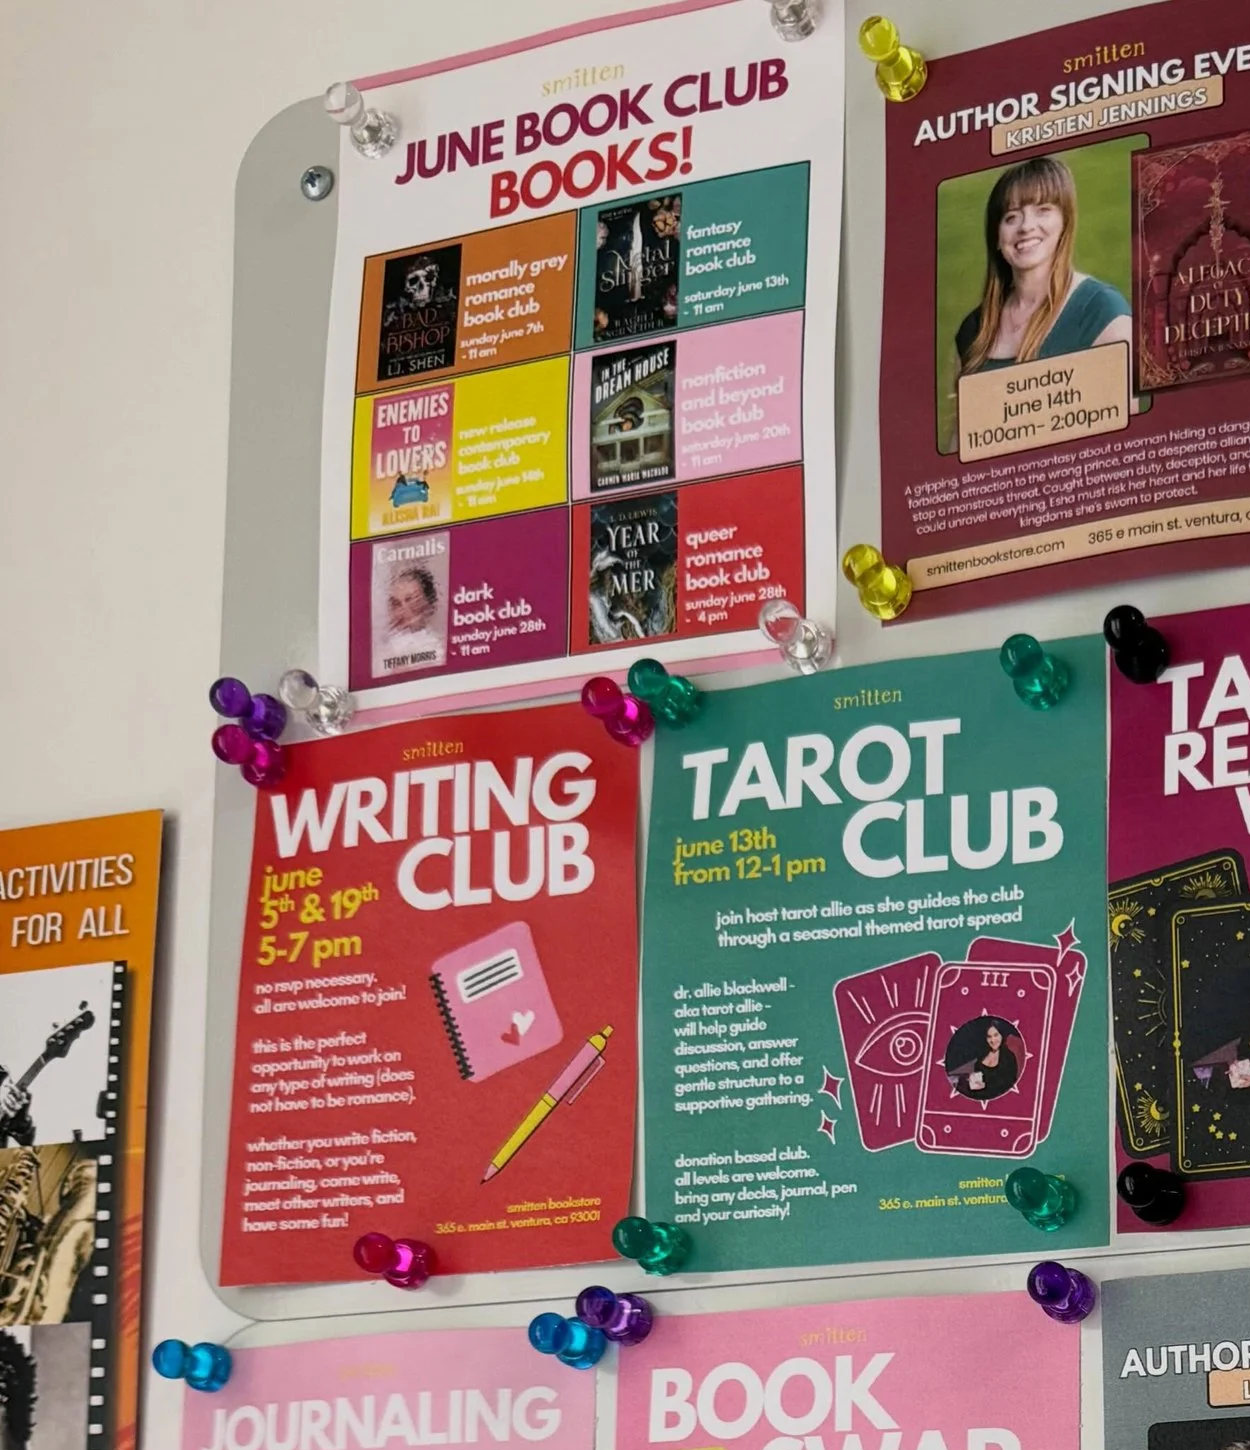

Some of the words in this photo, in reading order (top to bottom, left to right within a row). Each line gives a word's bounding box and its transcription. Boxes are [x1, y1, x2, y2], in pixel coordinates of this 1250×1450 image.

[395, 118, 503, 185] JUNE
[514, 82, 653, 157] BOOK
[662, 57, 788, 116] CLUB
[914, 92, 1039, 146] AUTHOR
[1050, 57, 1185, 109] SIGNING
[1006, 112, 1093, 149] KRISTEN
[1097, 87, 1208, 126] JENNINGS
[489, 127, 694, 219] BOOKS!
[685, 219, 742, 241] fantasy
[466, 259, 526, 286] morally
[529, 252, 568, 276] grey
[1005, 366, 1075, 396] sunday
[1002, 396, 1042, 424] june
[1046, 386, 1081, 412] 14th
[606, 521, 660, 550] YEAR
[685, 525, 737, 548] queer
[926, 538, 1065, 576] smittenbookstore.com
[1087, 528, 1113, 546] 365
[1116, 530, 1125, 541] e
[1128, 518, 1163, 538] main
[1166, 517, 1181, 533] st.
[1185, 508, 1241, 530] ventura,
[453, 584, 494, 604] dark
[611, 570, 656, 596] MER
[683, 718, 960, 820] TAROT
[271, 751, 596, 858] WRITING
[674, 834, 724, 866] june
[729, 825, 777, 854] 13th
[842, 786, 1064, 878] CLUB
[259, 864, 323, 903] june
[397, 823, 595, 911] CLUB
[11, 912, 62, 947] FOR
[78, 904, 131, 940] ALL
[259, 897, 295, 929] 5th
[301, 900, 326, 925] &
[331, 883, 379, 922] 19th
[716, 909, 744, 930] join
[746, 906, 778, 924] host
[782, 903, 818, 921] tarot
[822, 899, 852, 918] allie
[855, 903, 874, 915] as
[878, 896, 904, 914] she
[907, 891, 960, 914] guides
[964, 890, 989, 905] the
[991, 885, 1024, 904] club
[257, 933, 308, 966] 5-7
[312, 937, 362, 968] pm
[648, 1353, 901, 1442] BOOK
